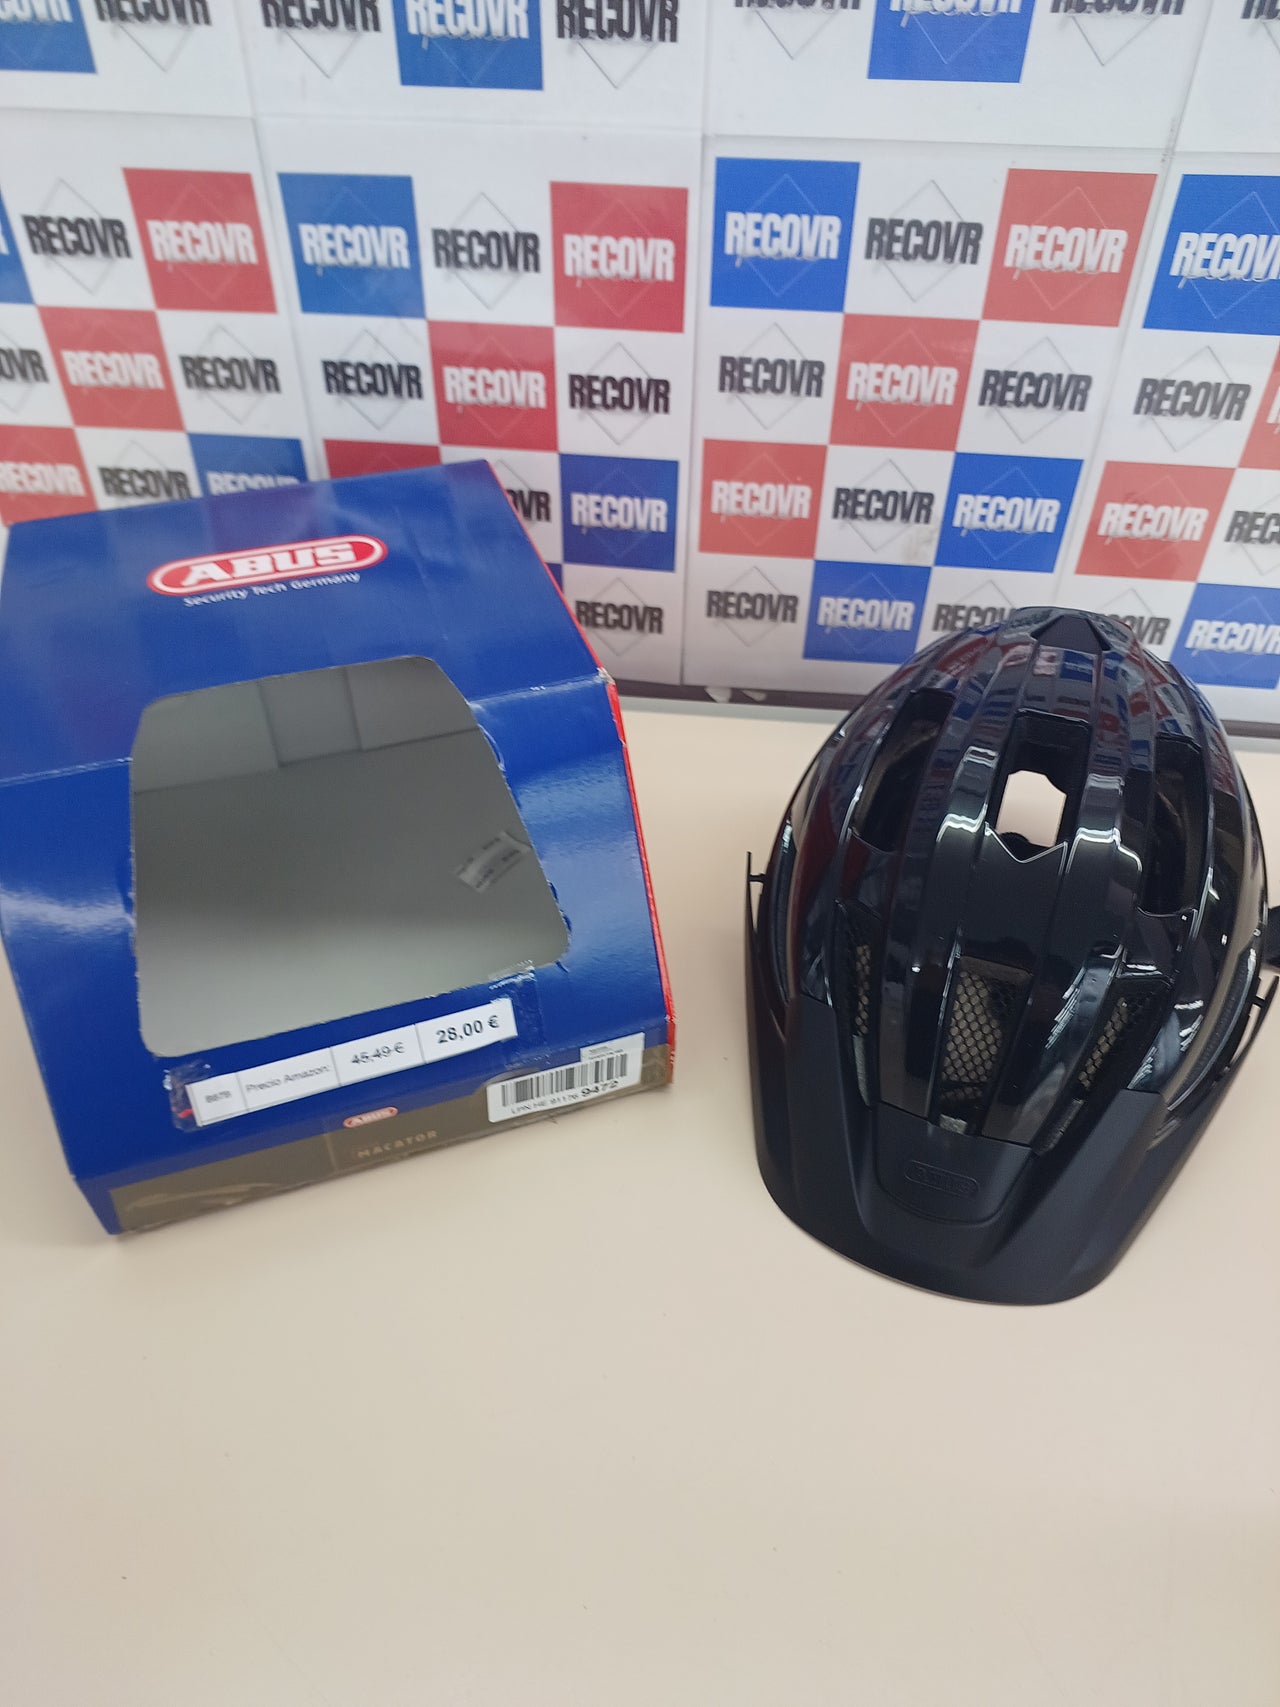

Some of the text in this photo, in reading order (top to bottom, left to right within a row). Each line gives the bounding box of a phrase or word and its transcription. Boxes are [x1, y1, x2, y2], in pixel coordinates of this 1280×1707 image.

[405, 0, 529, 39] RECOVR
[556, 0, 678, 42] RECOVR
[22, 215, 132, 260] RECOVR
[147, 220, 258, 265] RECOVR
[299, 223, 410, 269] RECOVR
[432, 228, 540, 273] RECOVR
[725, 211, 842, 260] RECOVR
[865, 217, 983, 265] RECOVR
[1003, 224, 1127, 273] RECOVR
[563, 234, 676, 281] RECOVR
[61, 350, 165, 389] RECOVR
[179, 355, 281, 393] RECOVR
[321, 360, 423, 399] RECOVR
[443, 366, 547, 408] RECOVR
[719, 356, 825, 397] RECOVR
[847, 362, 958, 405] RECOVR
[568, 374, 670, 414] RECOVR
[978, 369, 1092, 412] RECOVR
[1133, 378, 1251, 421] RECOVR
[98, 466, 192, 499] RECOVR
[711, 480, 812, 519] RECOVR
[571, 493, 668, 532] RECOVR
[832, 487, 934, 524] RECOVR
[952, 493, 1060, 534] RECOVR
[1097, 502, 1208, 542] RECOVR
[181, 542, 357, 587] ABUS
[183, 572, 361, 607] Security Tech Germany
[706, 589, 799, 623] RECOVR
[576, 600, 663, 634] RECOVR
[818, 597, 915, 631] RECOVR
[436, 1019, 484, 1044] 28,00
[488, 1015, 500, 1029] €
[357, 1130, 438, 1159] MACATOR
